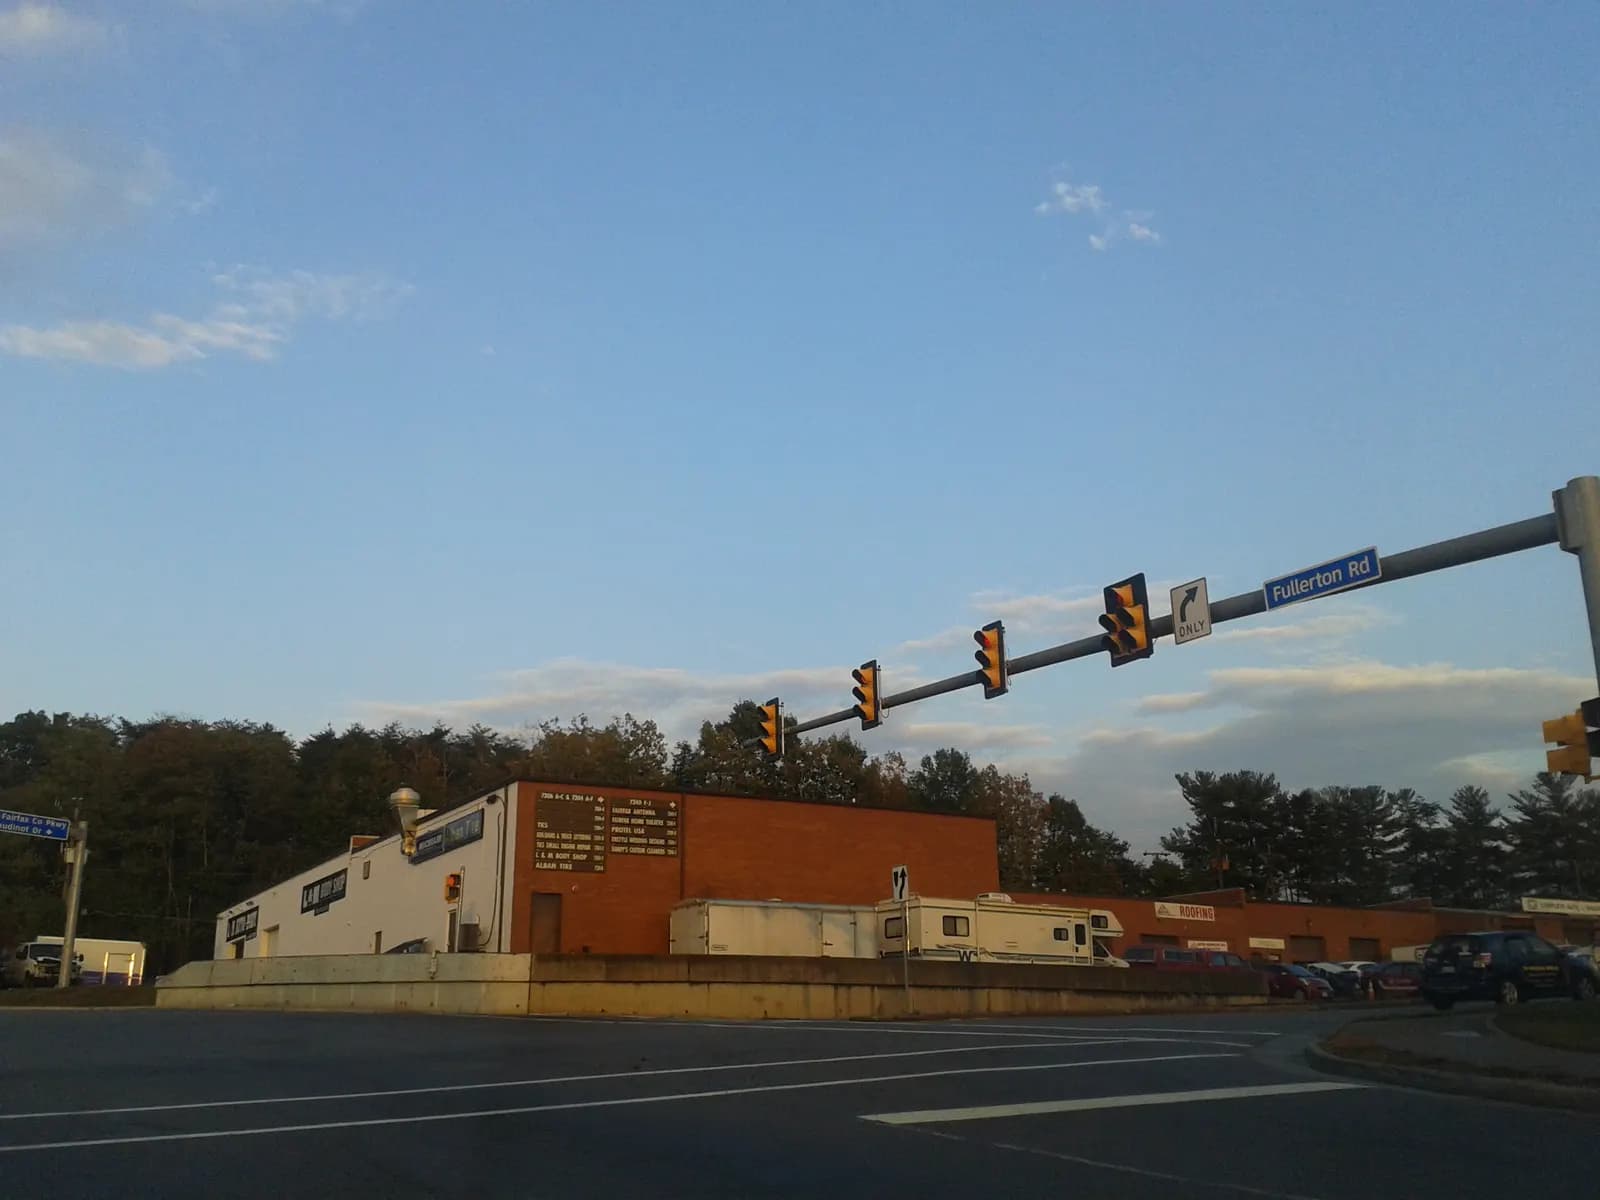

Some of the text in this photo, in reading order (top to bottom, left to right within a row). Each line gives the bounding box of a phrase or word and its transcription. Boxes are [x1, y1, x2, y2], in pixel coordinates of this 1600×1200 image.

[1272, 556, 1370, 602] Fullerton Rd
[1179, 620, 1205, 637] ONLY
[1, 813, 29, 823] Fairfax
[46, 820, 67, 830] Pkwy
[1180, 905, 1213, 919] ROOFING
